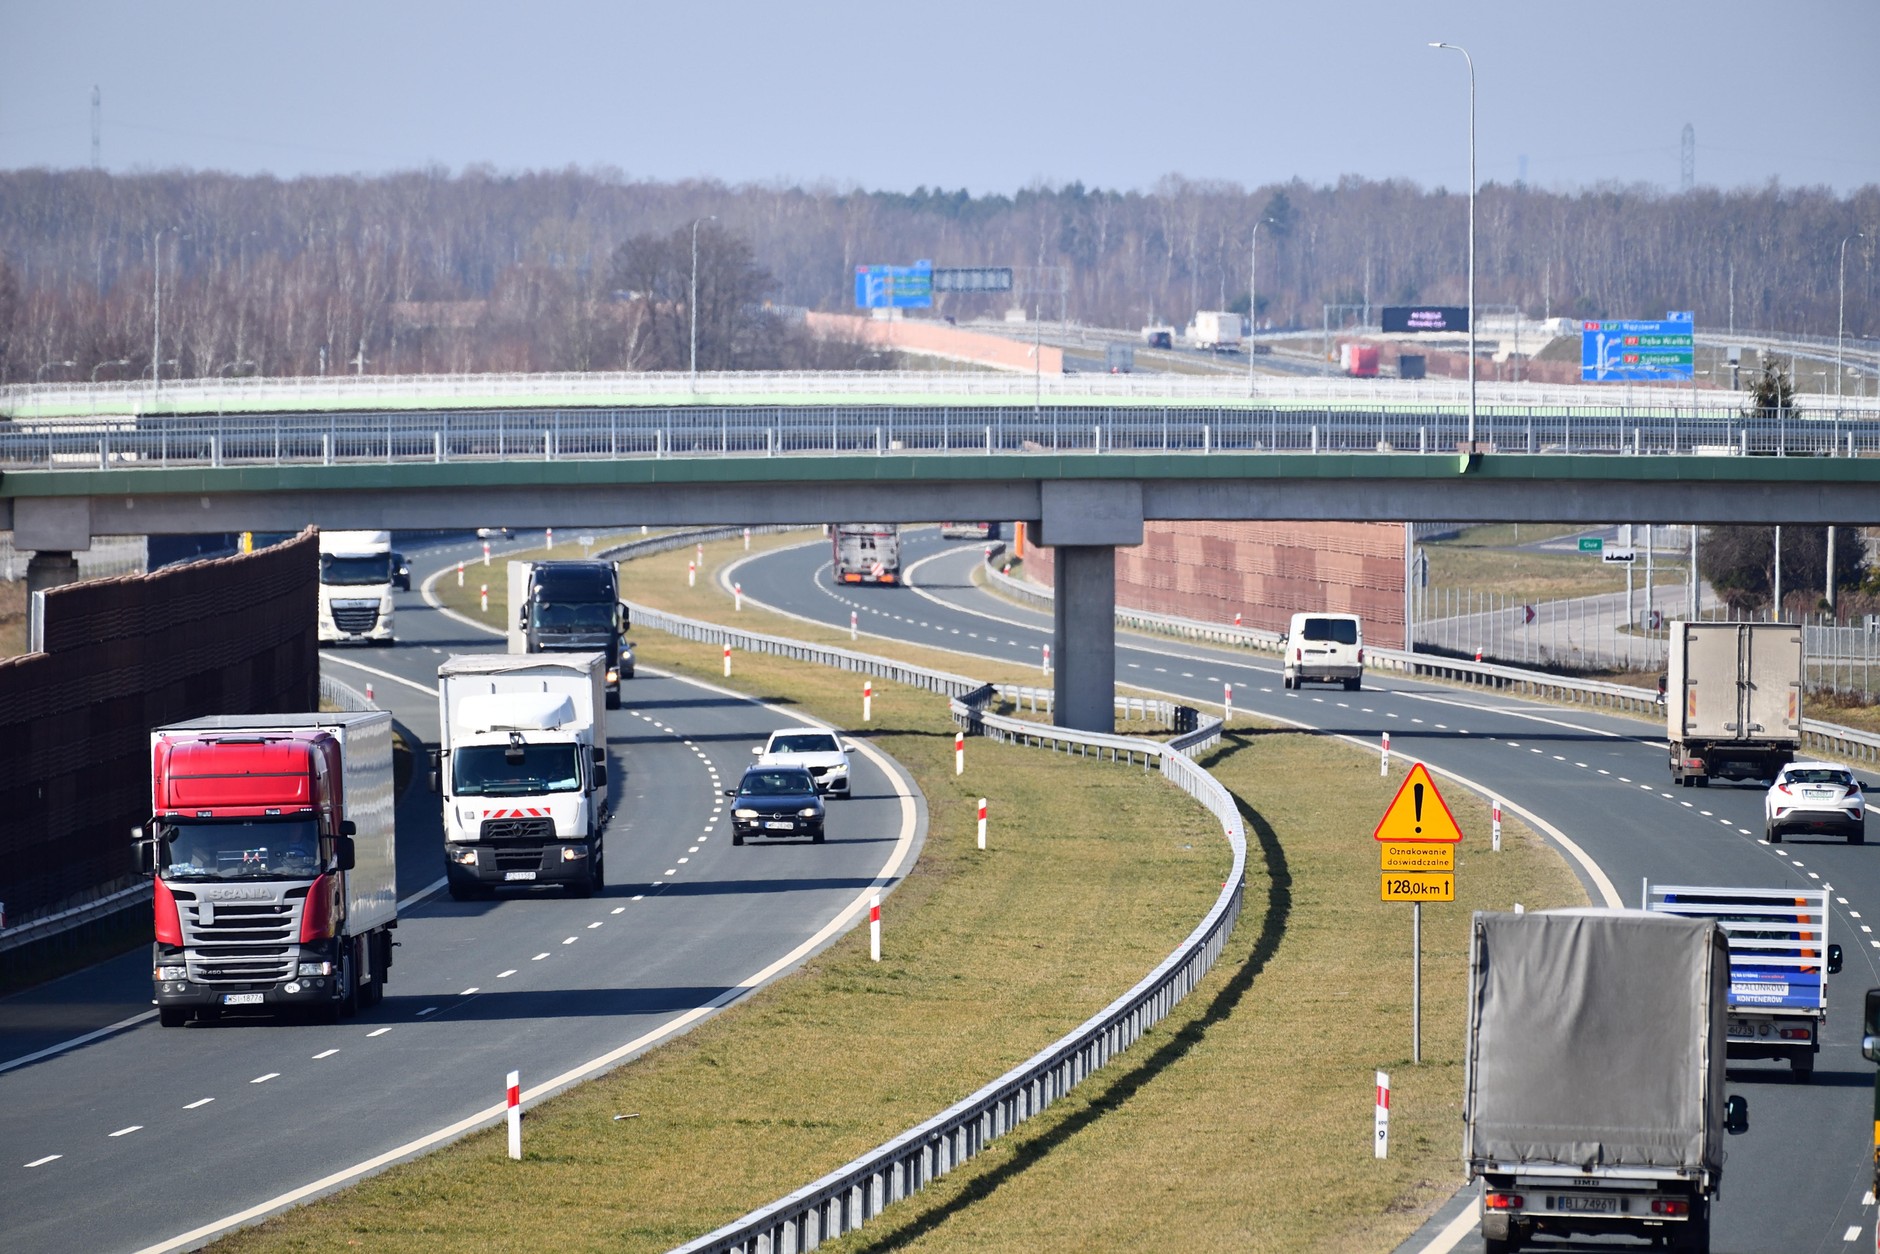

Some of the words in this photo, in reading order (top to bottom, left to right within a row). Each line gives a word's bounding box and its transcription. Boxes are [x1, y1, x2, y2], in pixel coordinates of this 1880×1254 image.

[1389, 847, 1447, 855] Oznakowanie
[209, 887, 272, 899] SCANIA
[1378, 1130, 1385, 1140] 9
[1583, 1199, 1613, 1210] 7496Y
